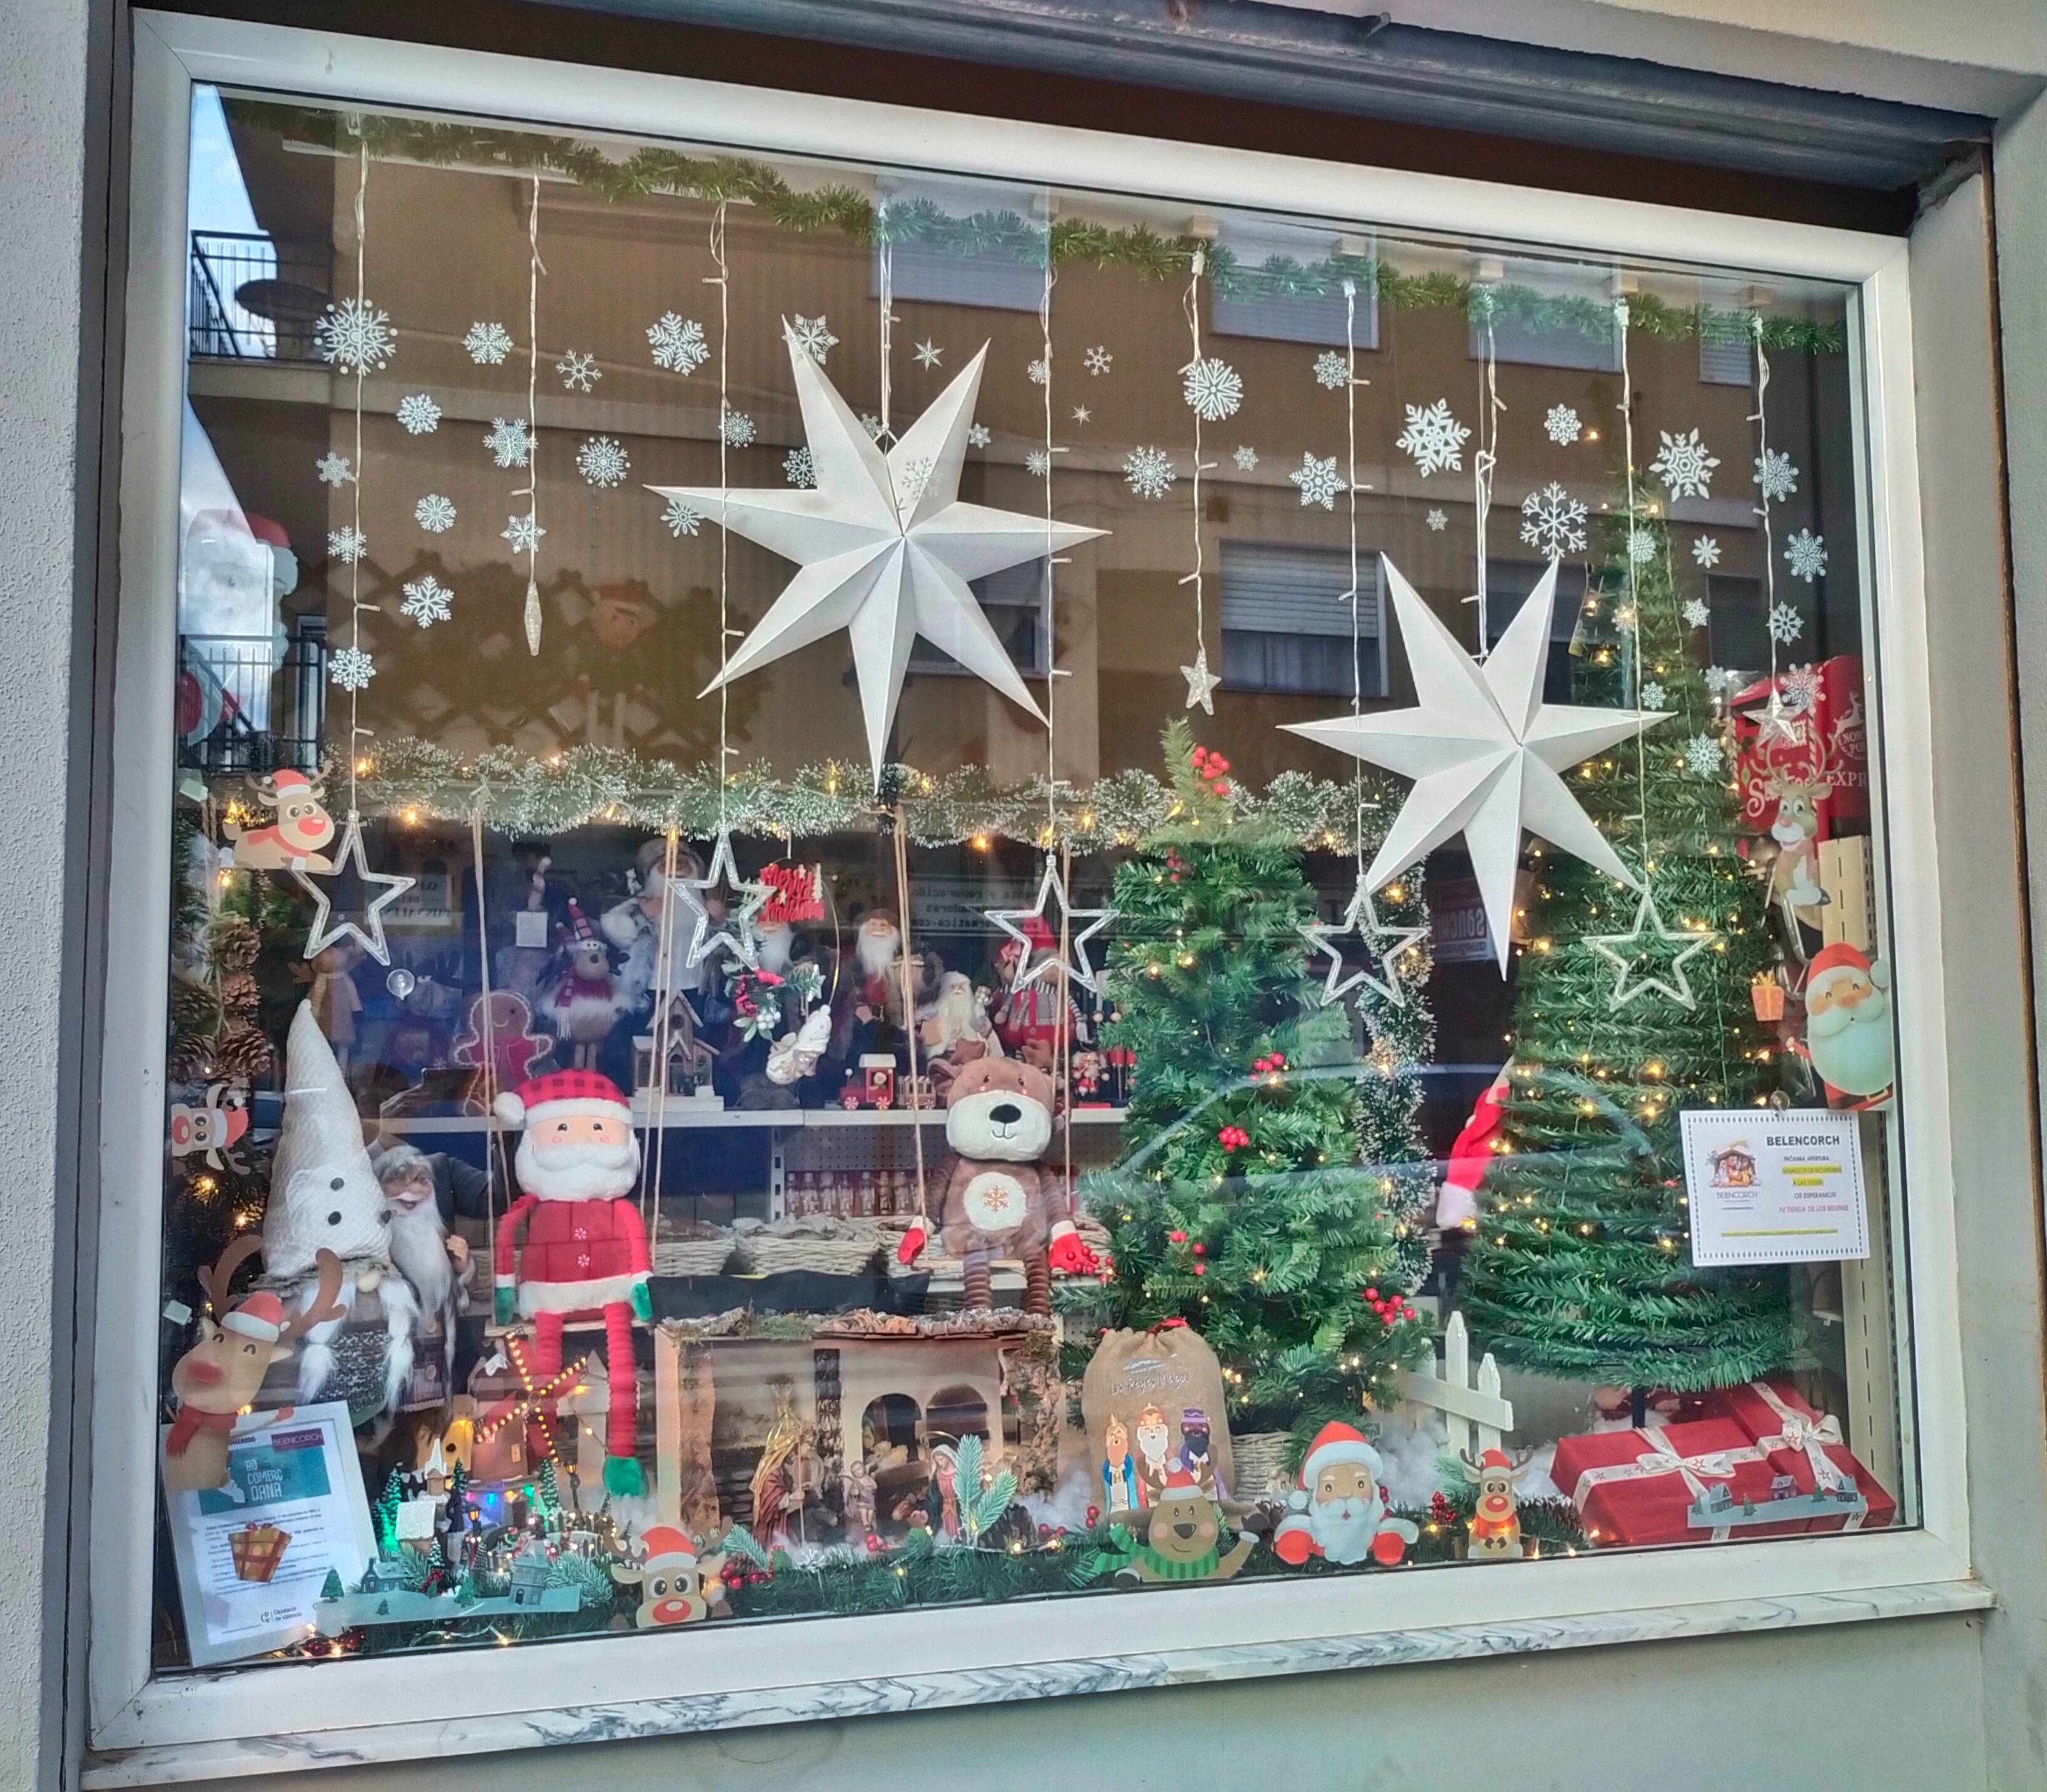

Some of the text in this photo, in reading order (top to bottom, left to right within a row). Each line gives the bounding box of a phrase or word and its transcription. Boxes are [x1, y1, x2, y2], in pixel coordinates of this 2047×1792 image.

[1767, 1136, 1840, 1146] BELENCORCH
[273, 1433, 322, 1446] BELENCORCH
[245, 1459, 257, 1471] BO
[250, 1482, 283, 1501] DANA
